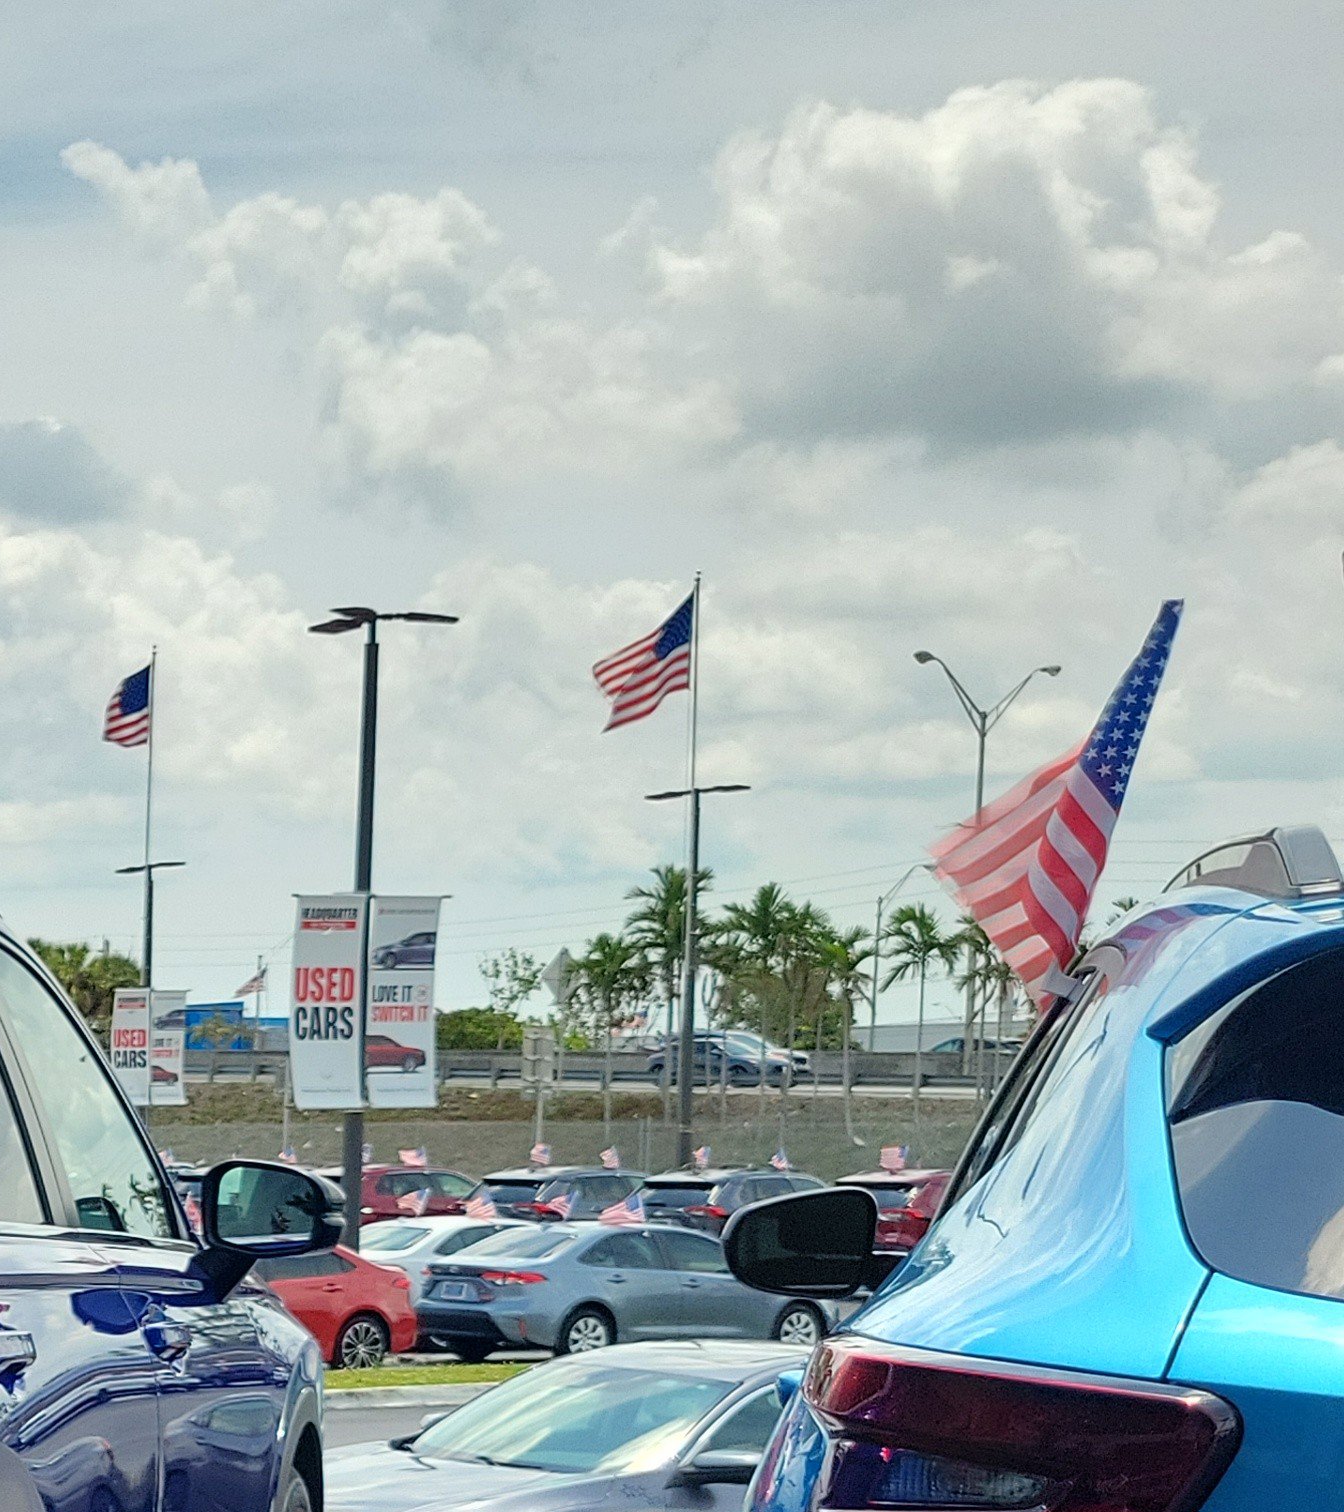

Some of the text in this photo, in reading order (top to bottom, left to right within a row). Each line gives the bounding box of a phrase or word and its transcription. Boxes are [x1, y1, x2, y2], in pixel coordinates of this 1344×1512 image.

[295, 967, 355, 1002] USED
[372, 985, 398, 1003] LOVE
[401, 985, 414, 1002] IT
[294, 1006, 354, 1041] CARS
[372, 1005, 429, 1023] SWITCH IT
[114, 1029, 146, 1048] USED
[113, 1050, 147, 1069] CARS
